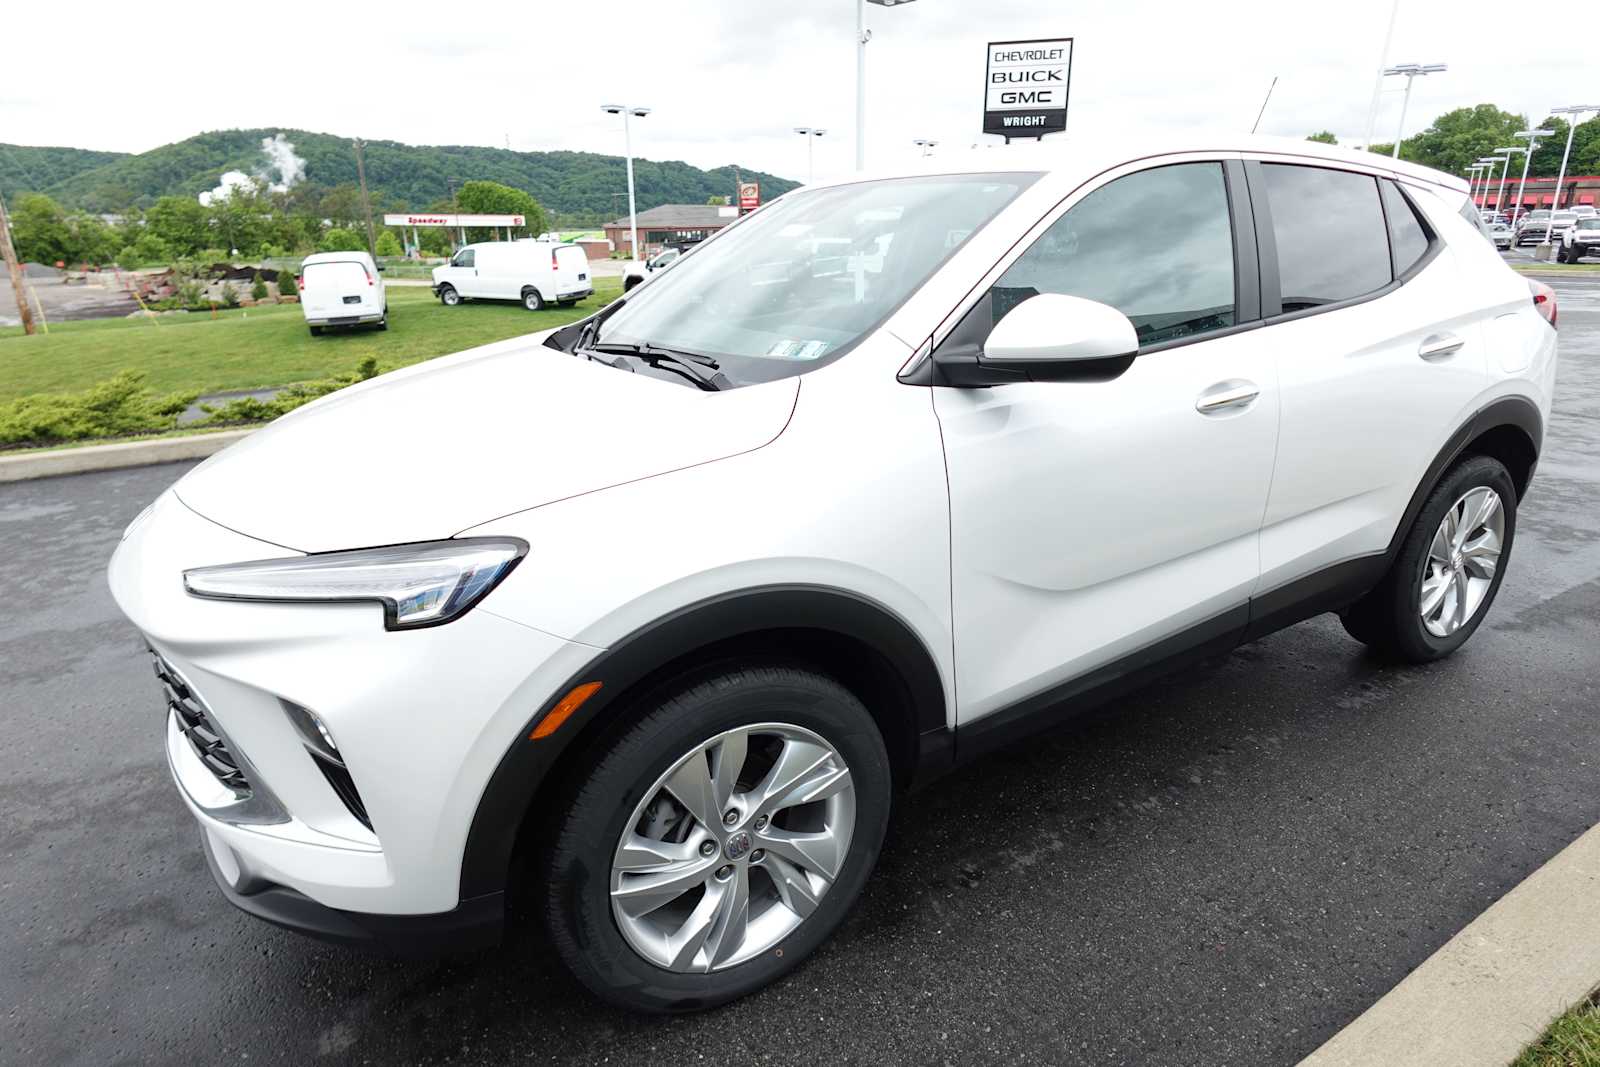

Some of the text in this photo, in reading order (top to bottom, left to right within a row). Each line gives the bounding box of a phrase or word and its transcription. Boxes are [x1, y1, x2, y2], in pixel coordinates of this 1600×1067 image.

[994, 49, 1064, 62] CHEVROLET
[992, 69, 1063, 83] BUICK
[1001, 90, 1052, 104] GMC
[1003, 115, 1046, 127] WRIGHT
